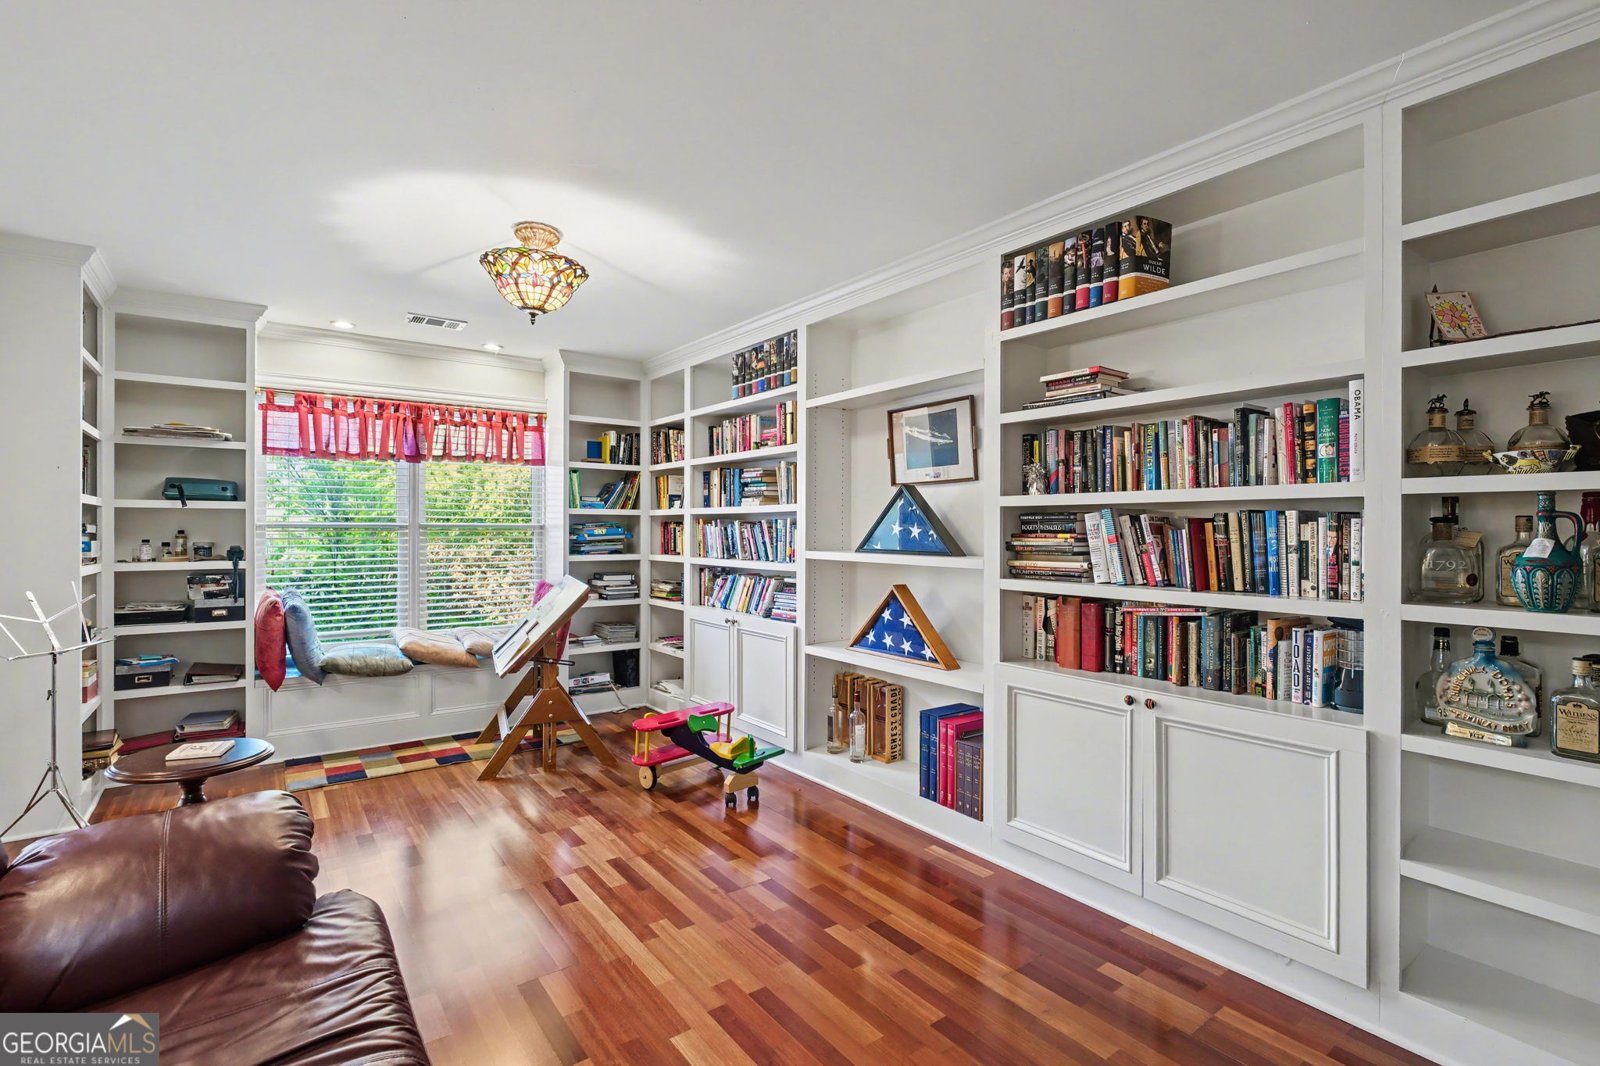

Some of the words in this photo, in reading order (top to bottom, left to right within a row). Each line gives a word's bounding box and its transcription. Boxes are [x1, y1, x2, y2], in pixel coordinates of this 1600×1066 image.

[1142, 263, 1166, 275] WILDE
[1339, 419, 1350, 449] LONDON
[1339, 451, 1350, 476] RULES
[1427, 560, 1467, 571] 1792
[1448, 665, 1487, 702] CHURCHILL
[1491, 670, 1518, 708] DOWNS
[890, 687, 898, 718] GRADE
[890, 720, 898, 760] HIGHEST
